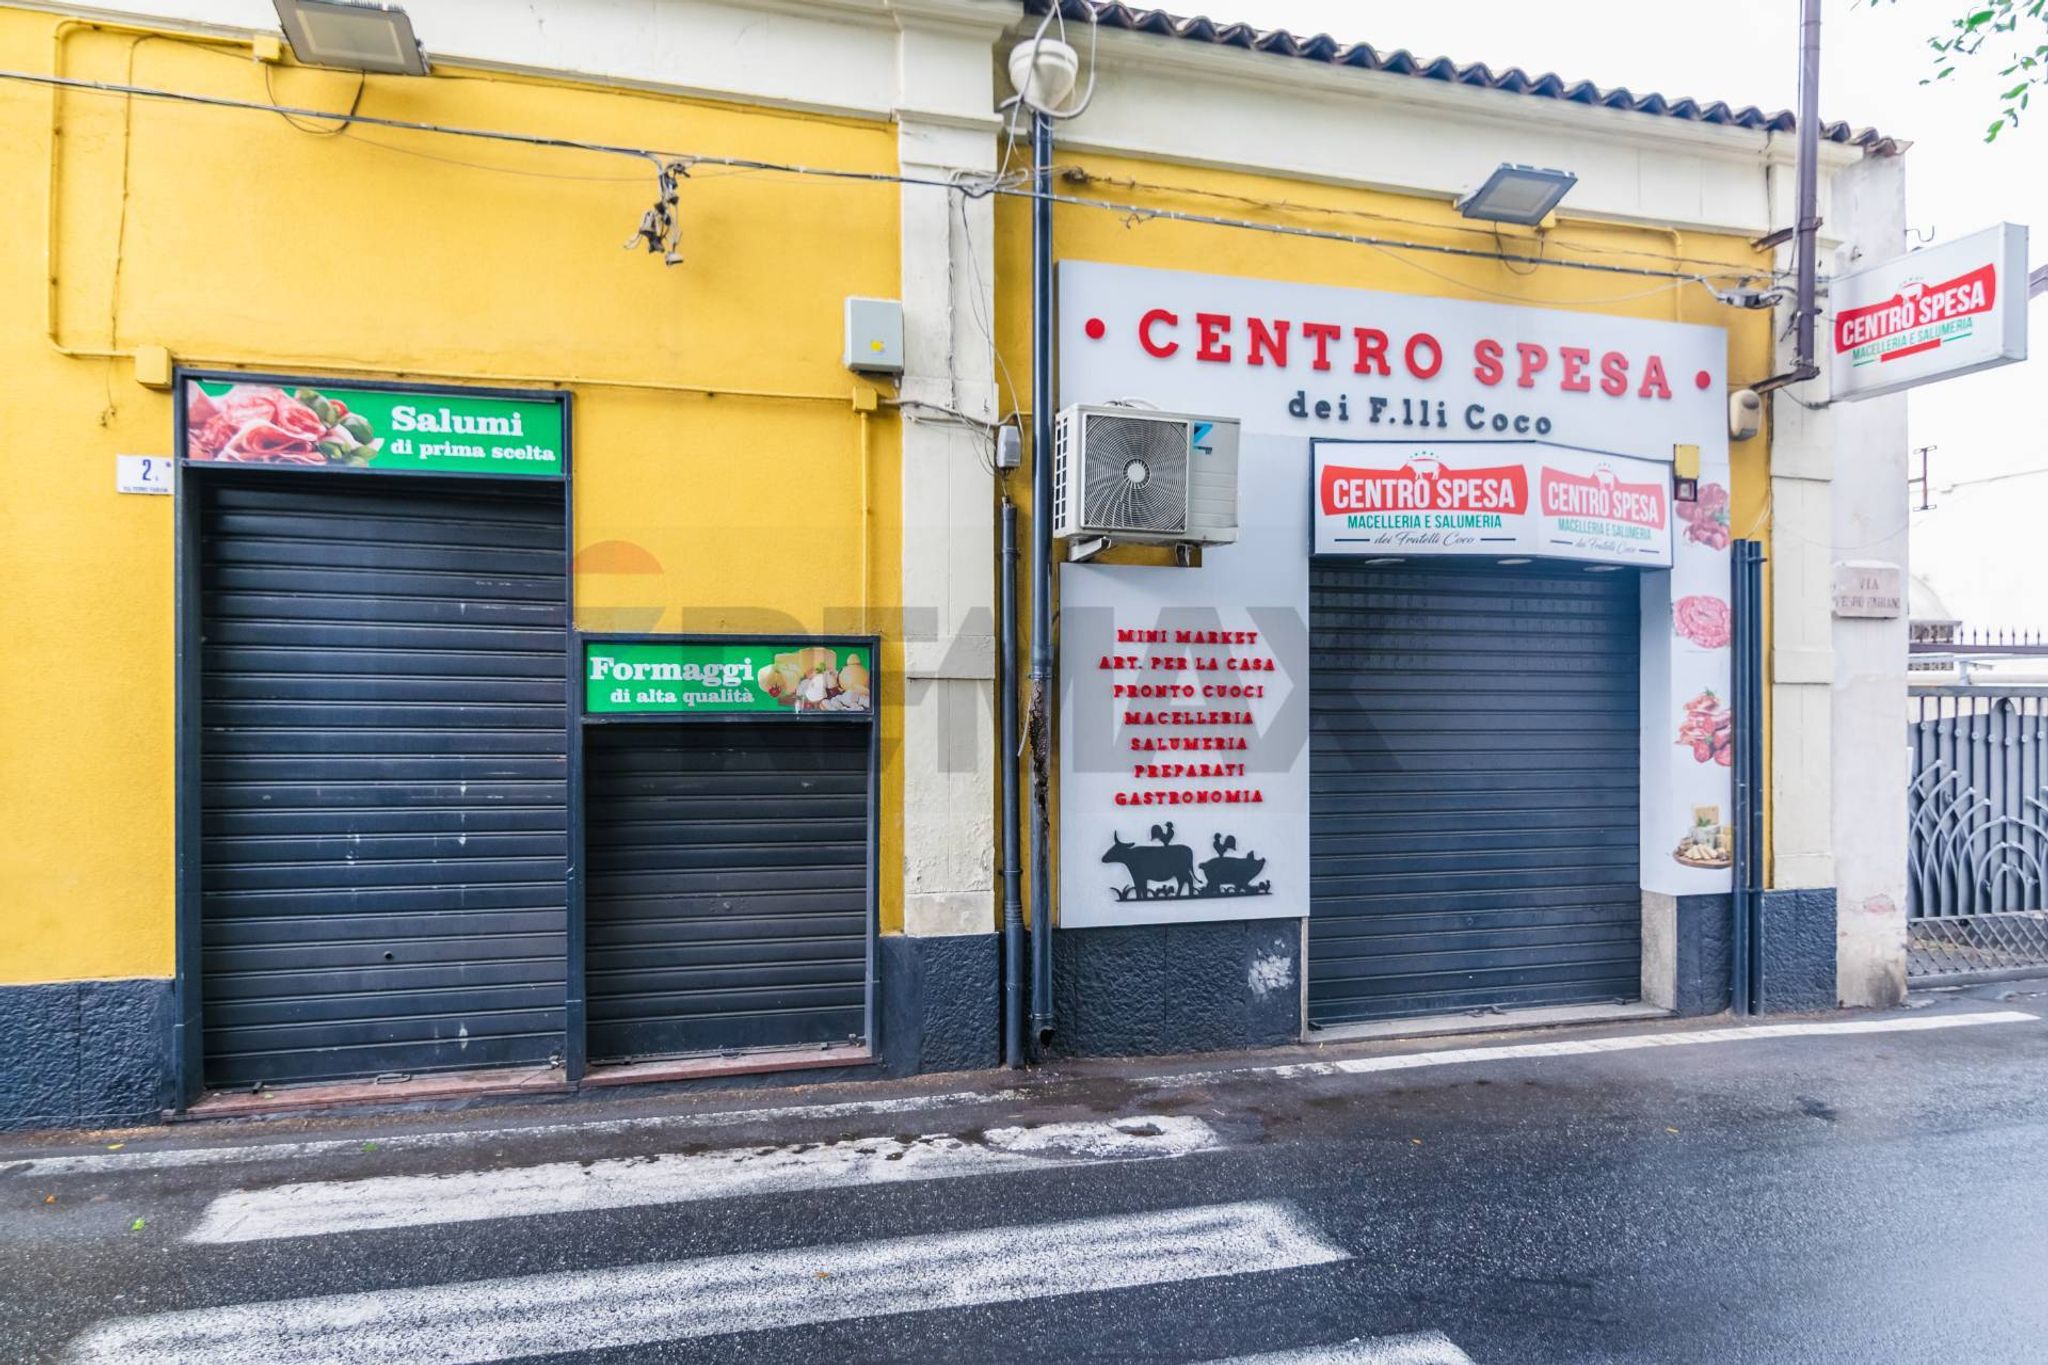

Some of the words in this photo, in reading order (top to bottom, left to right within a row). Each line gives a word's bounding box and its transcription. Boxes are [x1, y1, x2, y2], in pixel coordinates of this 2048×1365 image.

[1842, 301, 1915, 346] CENTRO
[1918, 280, 1986, 324] SPESA
[1852, 335, 1907, 360] MACELLERIA
[1908, 333, 1916, 344] E
[1917, 317, 1974, 342] SALUMERIA
[1138, 309, 1443, 381] CENTRO
[1473, 338, 1672, 399] SPESA
[391, 405, 524, 437] Salumi
[1288, 391, 1349, 421] dei
[1369, 396, 1448, 428] F.lli
[1464, 403, 1552, 435] Coco
[390, 438, 413, 455] di
[419, 440, 486, 460] prima
[491, 444, 556, 462] scelta
[1333, 478, 1430, 509] CENTRO
[1436, 478, 1516, 509] SPESA
[1548, 481, 1609, 517] CENTRO
[1612, 489, 1659, 523] SPESA
[1347, 514, 1421, 529] MACELLERIA
[1424, 515, 1432, 529] E
[1434, 514, 1502, 529] SALUMERIA
[1557, 518, 1604, 535] MACELLERIA
[1374, 533, 1391, 545] dei
[1394, 531, 1439, 546] Fratelli
[1443, 532, 1475, 547] Coco
[1858, 578, 1880, 590] VIA
[1117, 629, 1167, 643] MINI
[1175, 630, 1257, 644] MARKET
[590, 656, 754, 687] Formaggi
[1099, 656, 1142, 670] ART.
[1151, 657, 1187, 670] PER
[1196, 657, 1218, 671] LA
[1227, 658, 1275, 671] CASA
[610, 688, 631, 703] di
[636, 688, 678, 703] alta
[682, 687, 755, 707] qualità
[1113, 685, 1194, 698] PRONTO
[1202, 685, 1264, 698] CUOCI
[1124, 711, 1253, 725] MACELLERIA
[1131, 737, 1247, 751] SALUMERIA
[1134, 764, 1245, 778] PREPARATI
[1115, 790, 1263, 806] GASTRONOMIA
